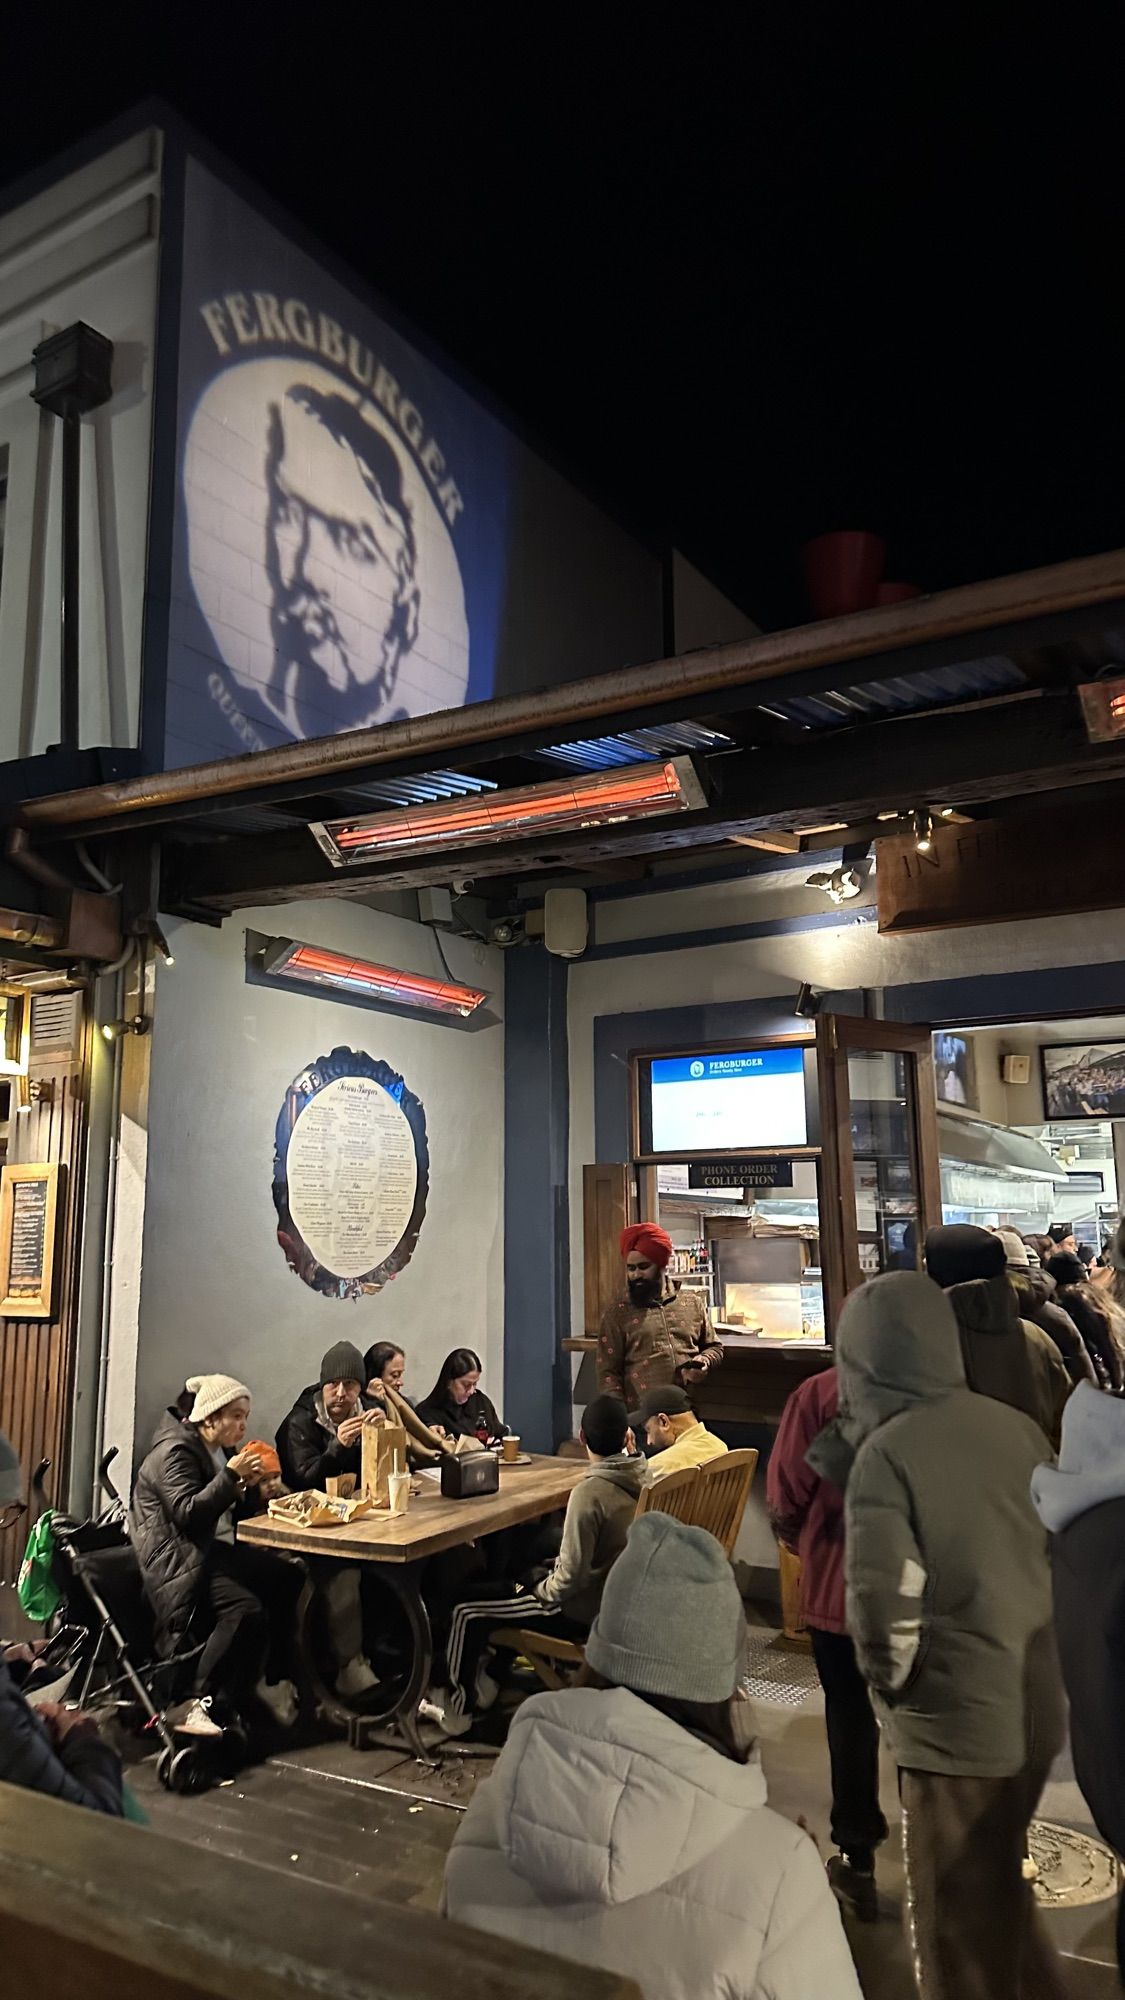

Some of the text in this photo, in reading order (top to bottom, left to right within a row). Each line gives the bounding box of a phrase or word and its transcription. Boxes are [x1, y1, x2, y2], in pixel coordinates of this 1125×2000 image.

[200, 290, 464, 527] FERGBURGER
[709, 1058, 763, 1069] FERGBURGER
[701, 1164, 778, 1175] PHONE ORDER
[704, 1175, 775, 1186] COLLECTION
